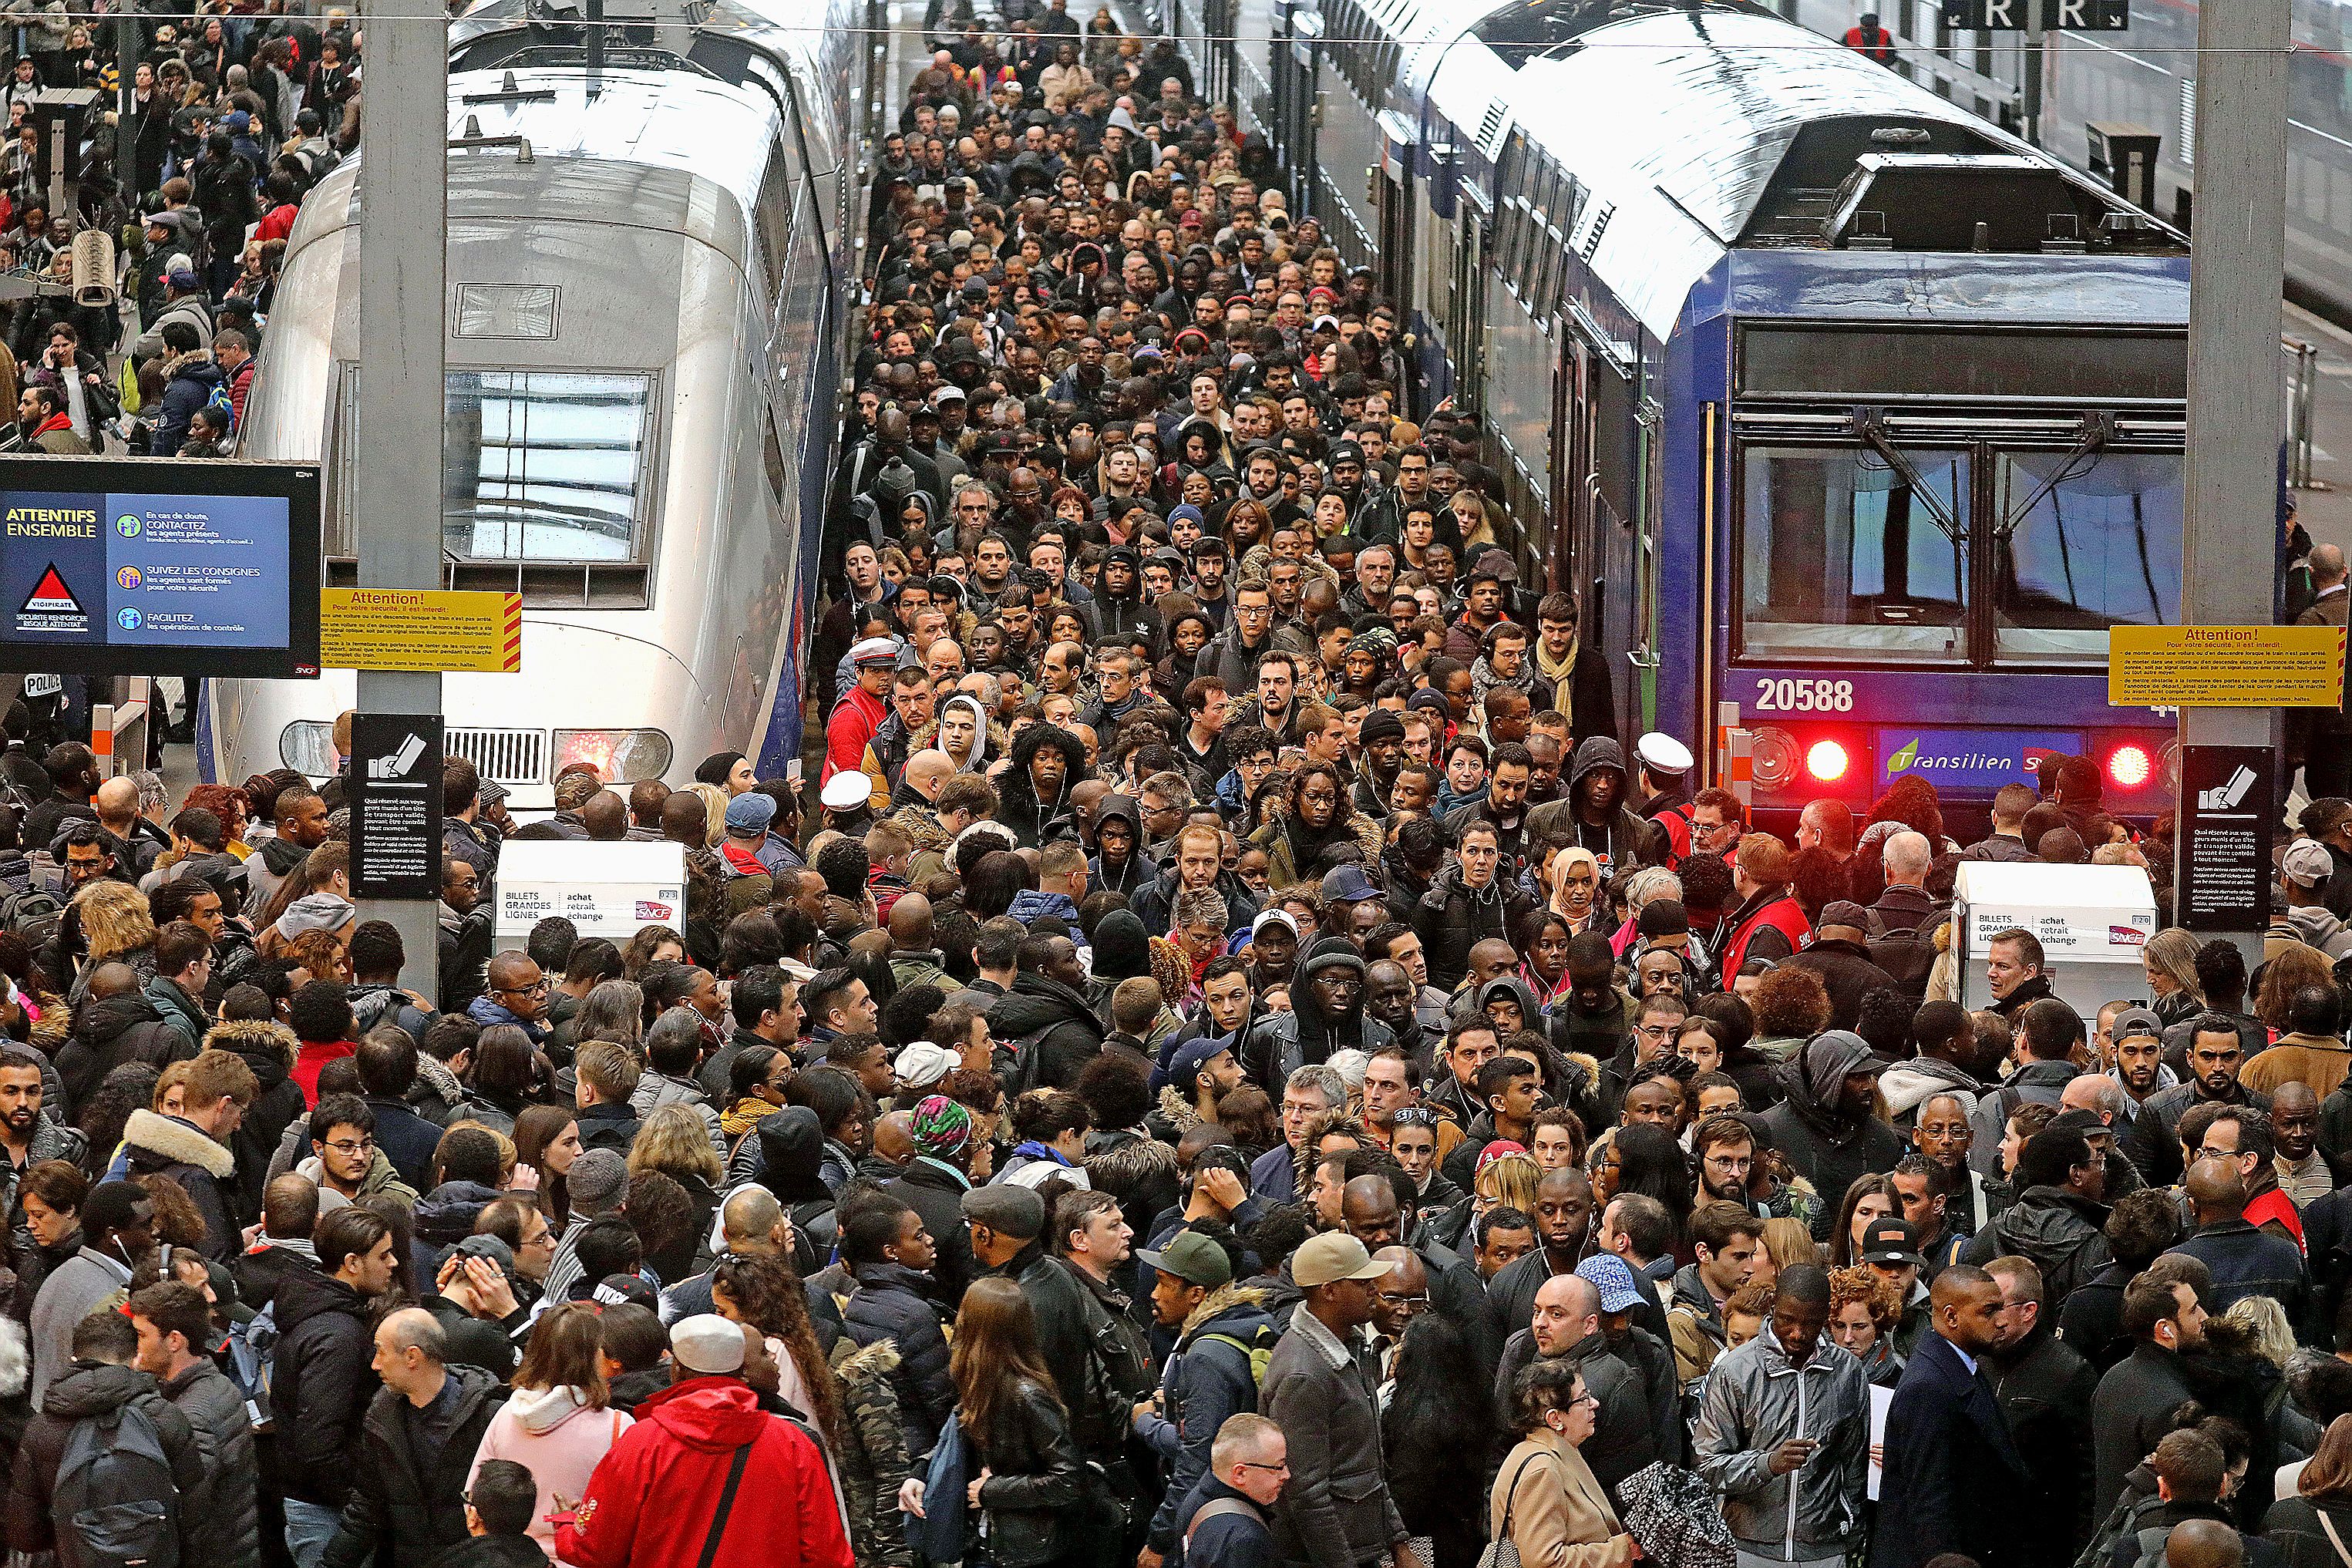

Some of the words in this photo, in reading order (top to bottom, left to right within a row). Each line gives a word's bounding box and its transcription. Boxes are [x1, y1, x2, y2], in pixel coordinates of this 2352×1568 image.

[1986, 0, 2012, 27] R
[2058, 0, 2085, 27] R
[6, 508, 96, 523] ATTENTIFS
[184, 513, 209, 521] doute,
[7, 523, 96, 537] ENSEMBLE
[146, 521, 207, 530] CONTACTEZ
[187, 530, 220, 539] présents
[146, 566, 181, 575] SUIVEZ
[183, 567, 200, 575] LES
[202, 567, 261, 577] CONSIGNES
[205, 577, 232, 585] formés
[351, 591, 424, 605] Attention!
[147, 613, 194, 623] FACILITEZ
[147, 623, 159, 631] les
[160, 623, 200, 633] opérations
[214, 624, 245, 632] contrôle
[2185, 628, 2258, 641] Attention!
[28, 675, 60, 692] POLICE
[1755, 678, 1853, 712] 20588
[1899, 749, 2012, 771] Transilien
[506, 892, 539, 900] BILLETS
[567, 893, 592, 901] achat
[505, 901, 551, 910] GRANDES
[567, 902, 596, 910] retrait
[505, 910, 539, 919] LIGNES
[567, 912, 603, 922] échange
[637, 907, 671, 919] SNCF
[1979, 914, 2012, 924] BILLETS
[2040, 917, 2065, 925] achat
[2040, 927, 2068, 935] retrait
[2040, 936, 2077, 946] échange
[2111, 932, 2145, 944] SNCF
